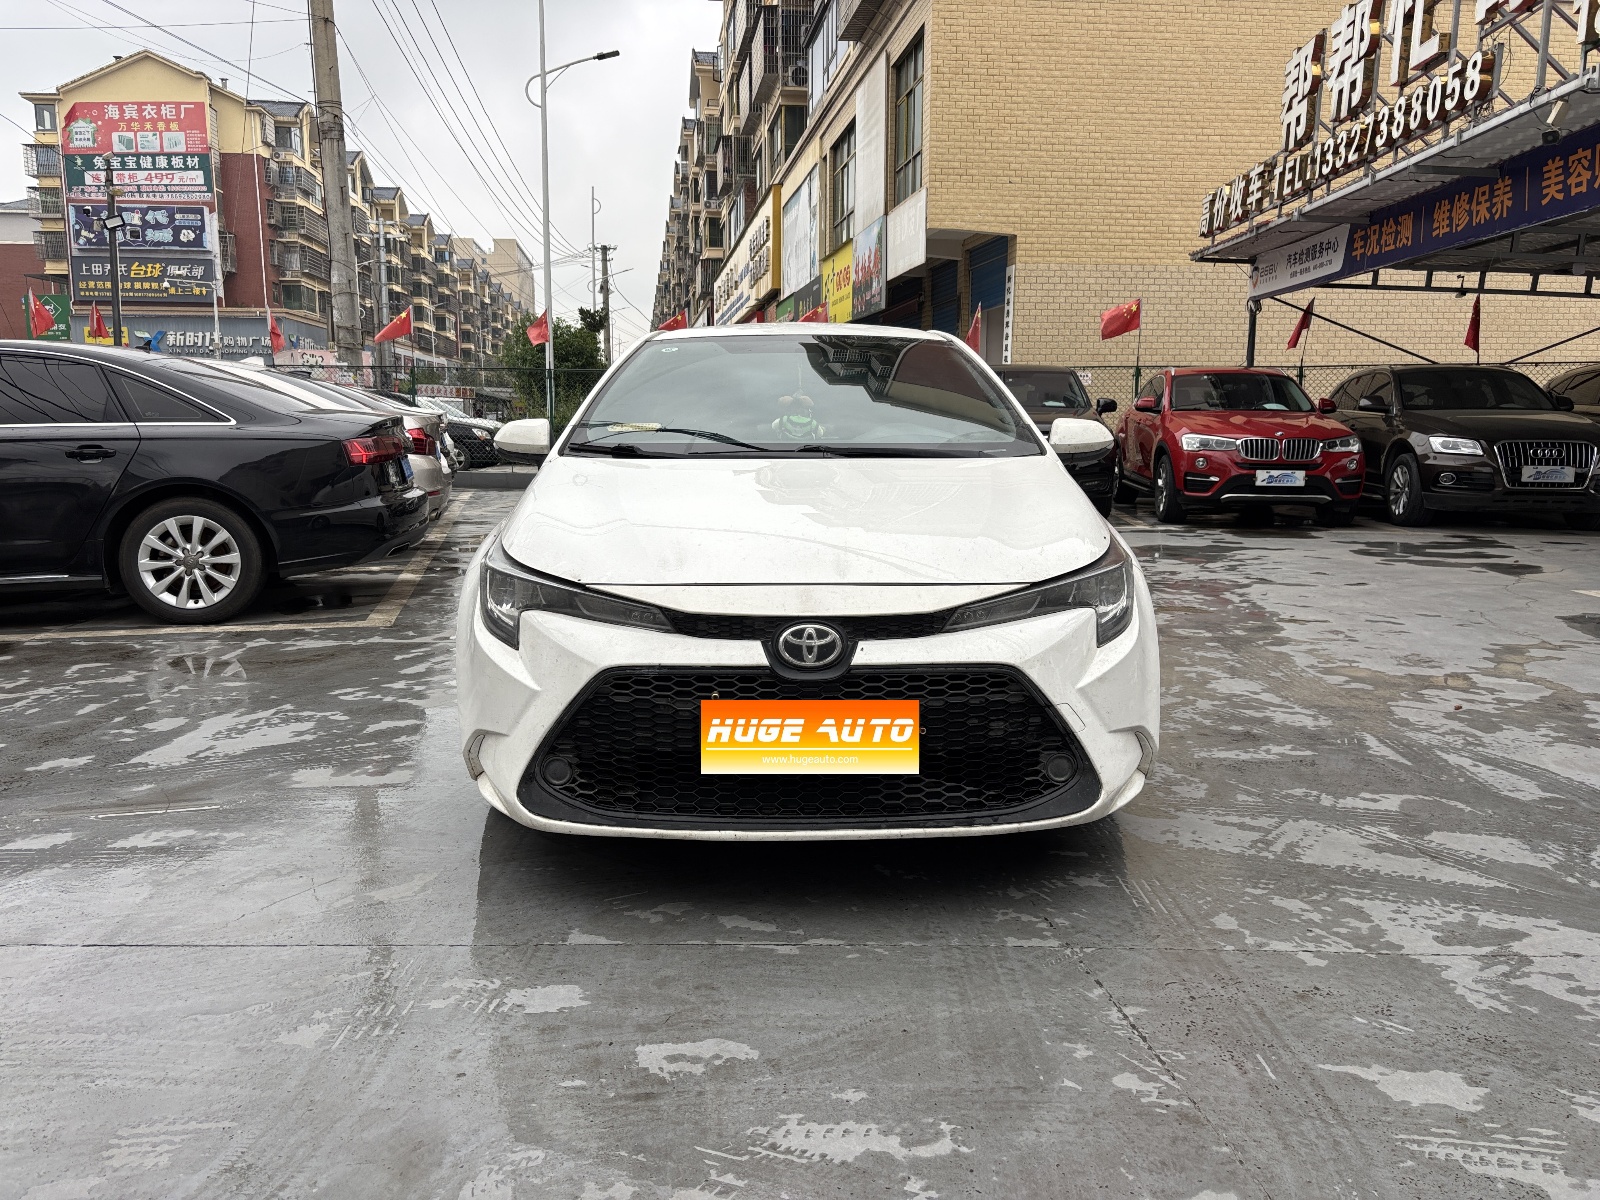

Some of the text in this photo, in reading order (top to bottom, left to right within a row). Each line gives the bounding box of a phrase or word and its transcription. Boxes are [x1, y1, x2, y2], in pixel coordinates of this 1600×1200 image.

[104, 104, 195, 119] 海宾衣柜厂
[93, 155, 200, 169] 兔宝宝健康板材
[91, 172, 139, 184] 连带柜
[1352, 211, 1414, 261] 车况检测
[1432, 175, 1513, 238] 维修保养
[1285, 236, 1340, 270] 汽车检测服务中心
